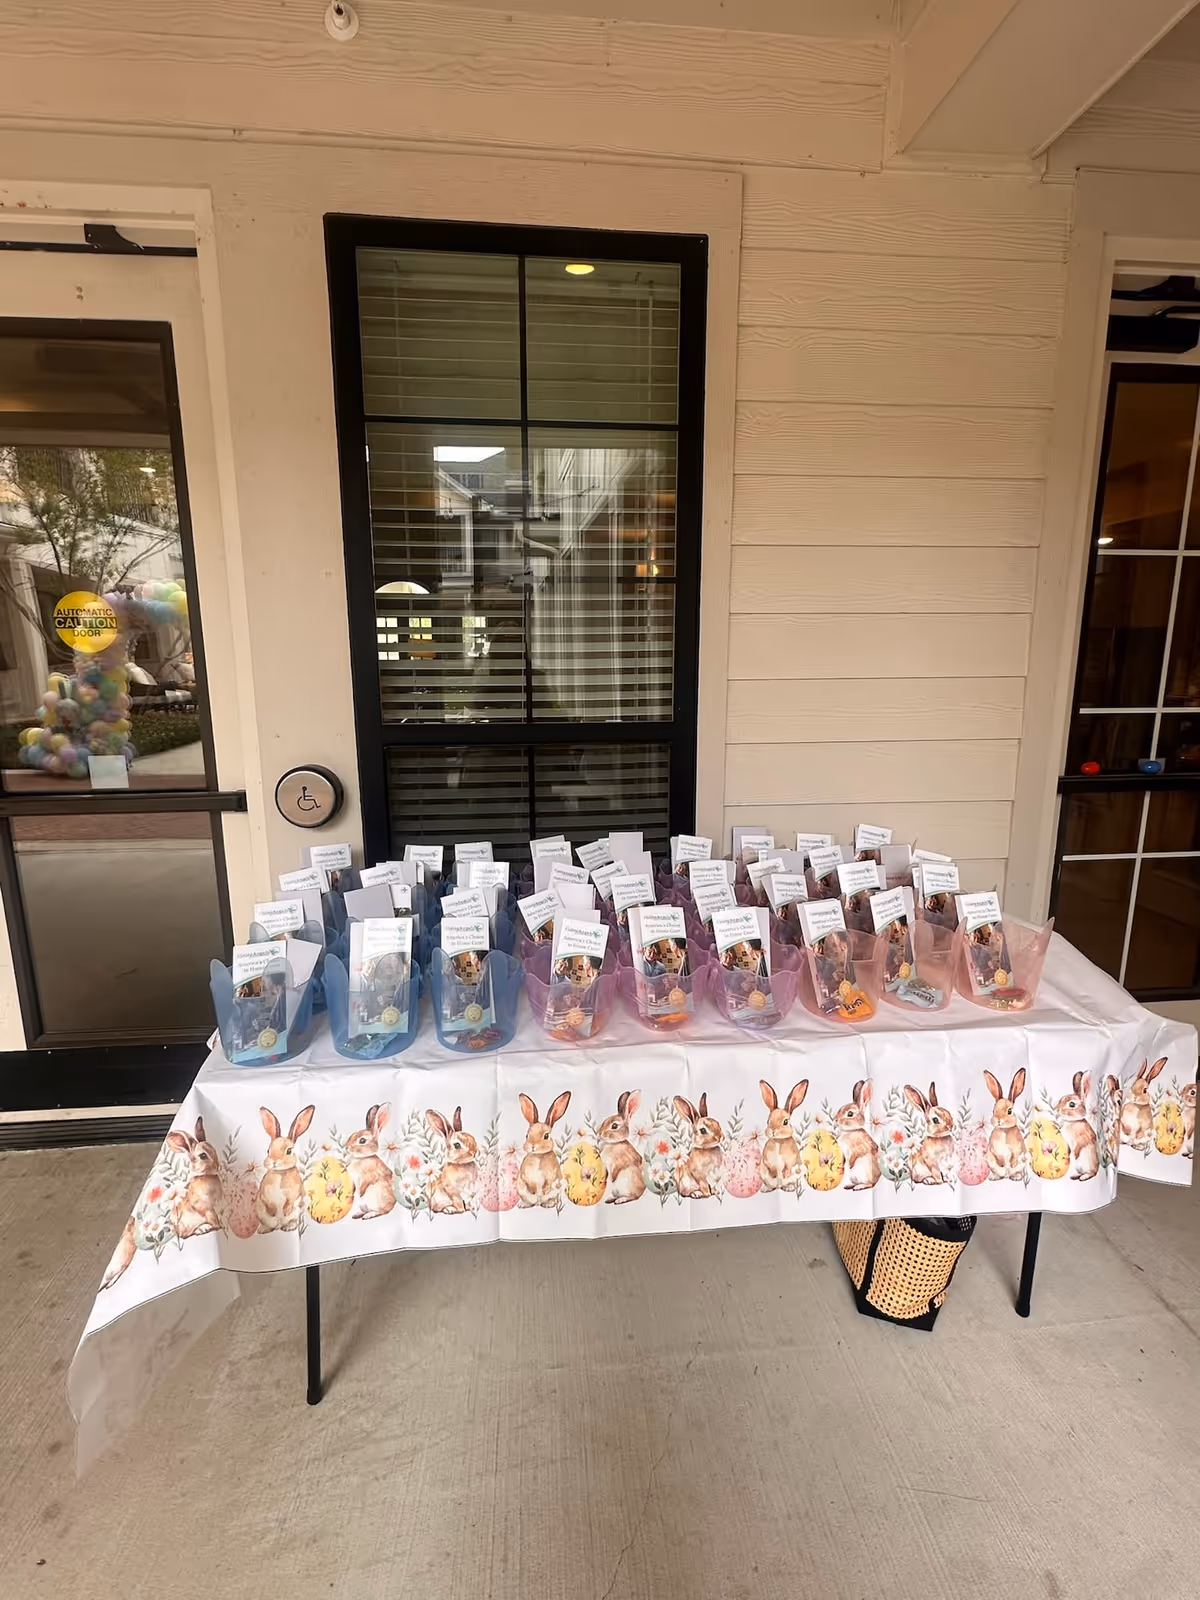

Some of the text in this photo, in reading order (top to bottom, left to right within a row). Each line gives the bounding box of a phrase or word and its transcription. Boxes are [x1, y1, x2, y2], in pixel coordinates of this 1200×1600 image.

[56, 608, 113, 617] AUTOMATIC
[54, 617, 117, 628] CAUTION
[73, 629, 101, 637] DOOR
